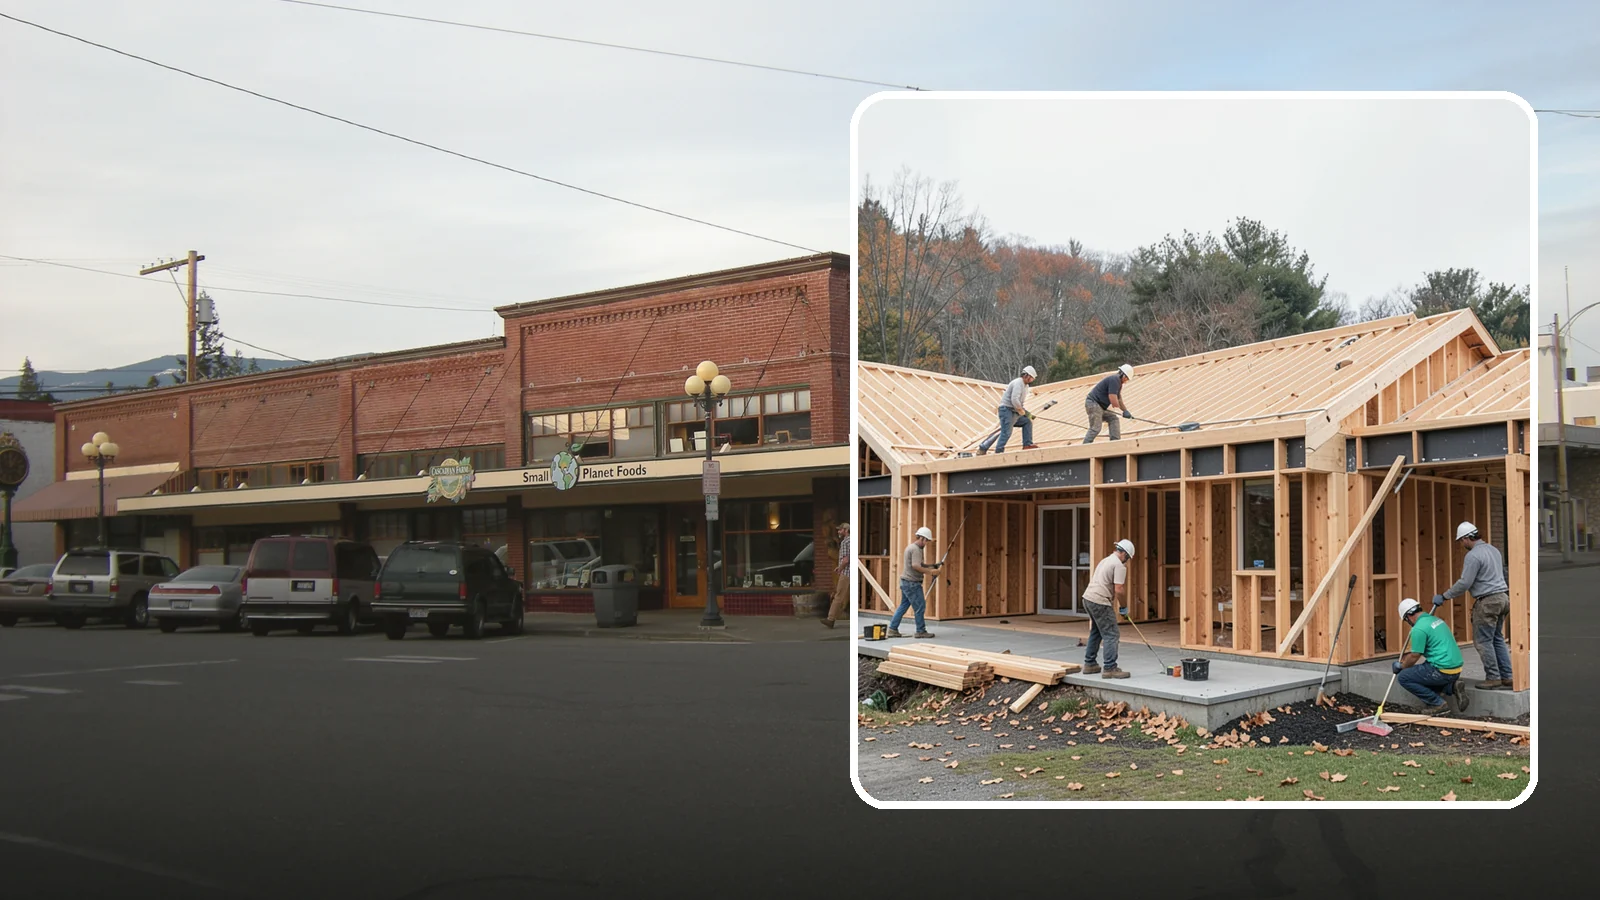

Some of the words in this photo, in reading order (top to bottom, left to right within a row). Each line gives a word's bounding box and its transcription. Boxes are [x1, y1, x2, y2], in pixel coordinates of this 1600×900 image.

[523, 471, 548, 482] Small
[583, 468, 614, 479] Planet
[617, 464, 647, 476] Foods
